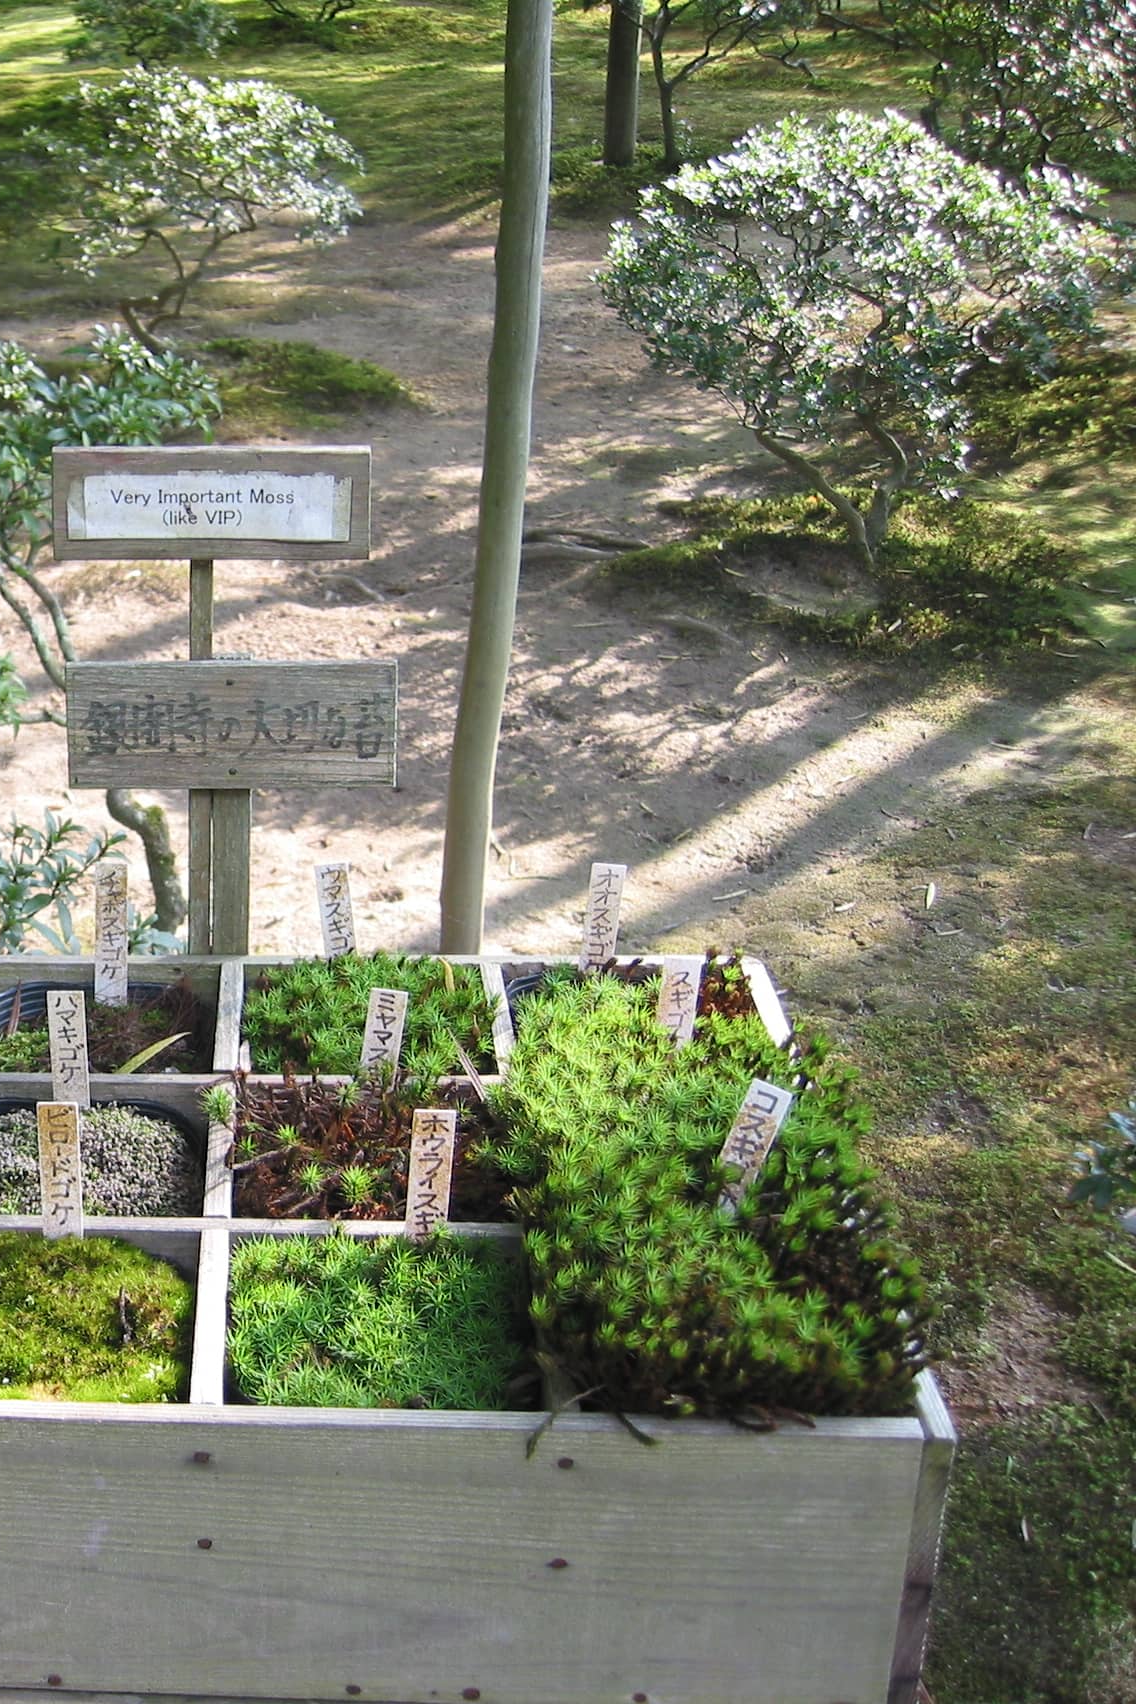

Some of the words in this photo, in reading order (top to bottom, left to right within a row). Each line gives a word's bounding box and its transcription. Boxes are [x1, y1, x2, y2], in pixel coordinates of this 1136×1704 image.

[111, 489, 151, 506] Very
[158, 489, 243, 506] Important
[250, 489, 294, 505] Moss
[163, 510, 198, 526] (like
[205, 510, 243, 526] VIP)
[321, 867, 354, 958] ウマスギゴ
[55, 995, 85, 1084] ハマキゴケ
[367, 992, 397, 1073] ミヤマス
[47, 1106, 77, 1226] ビロードゴケ
[414, 1115, 449, 1237] ホウライスギ
